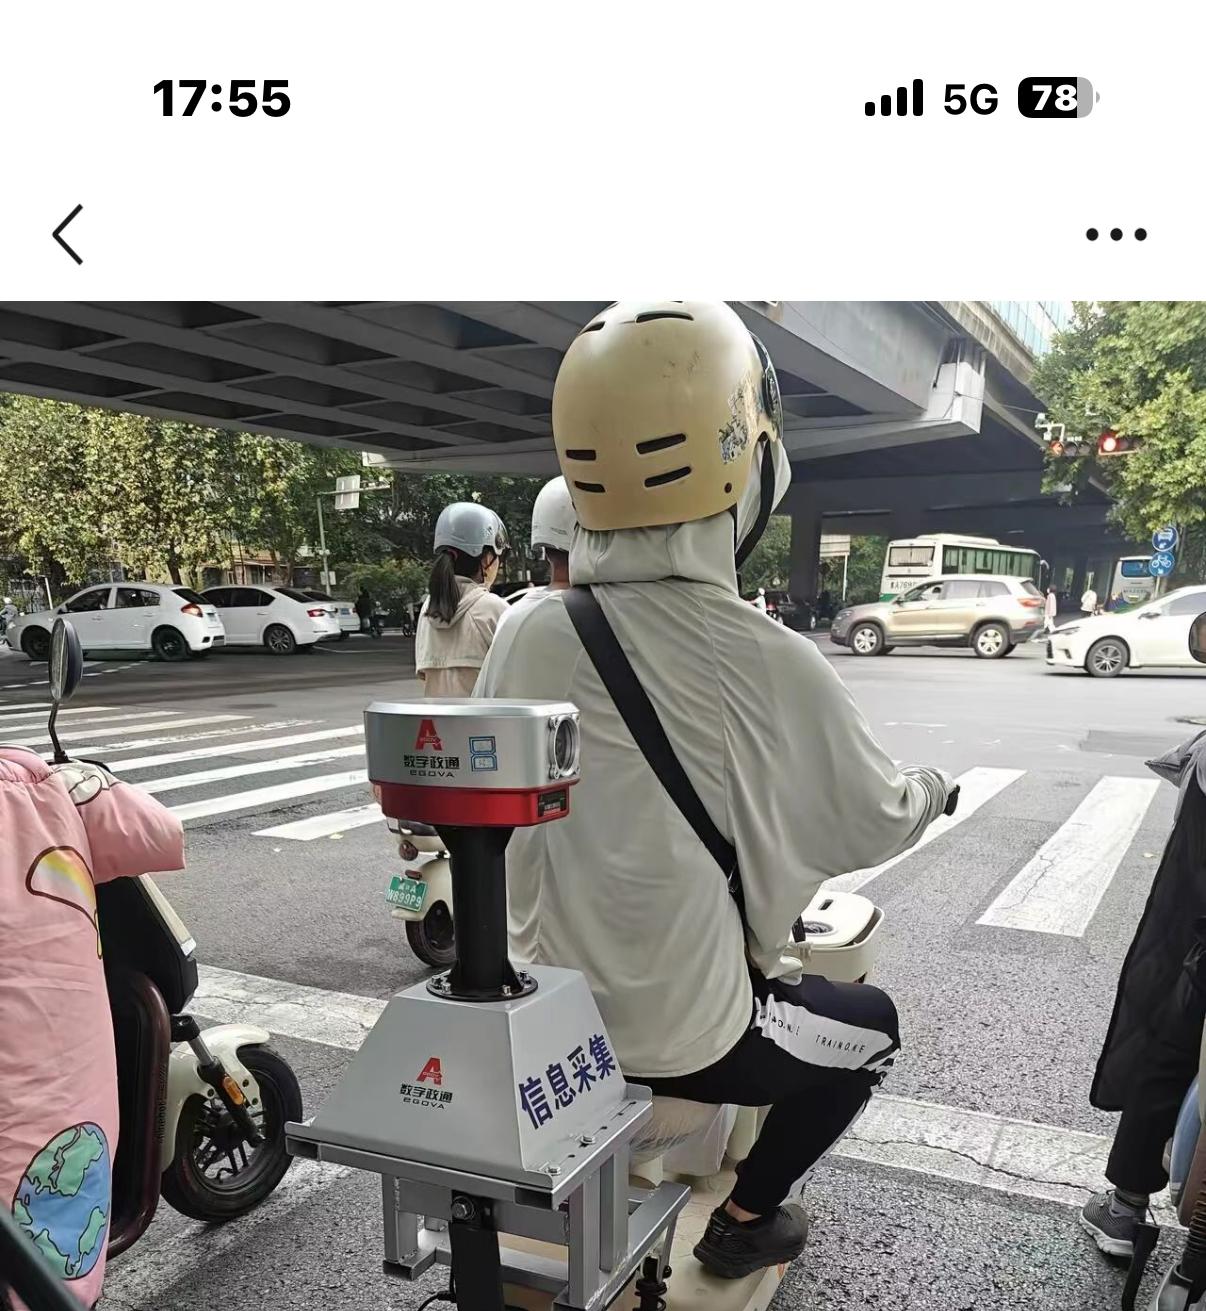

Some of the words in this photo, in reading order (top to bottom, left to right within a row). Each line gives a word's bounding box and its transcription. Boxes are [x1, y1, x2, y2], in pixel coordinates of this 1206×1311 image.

[403, 755, 460, 770] 数字政通
[518, 1033, 616, 1130] 信息采集
[400, 1083, 453, 1103] 数字政通
